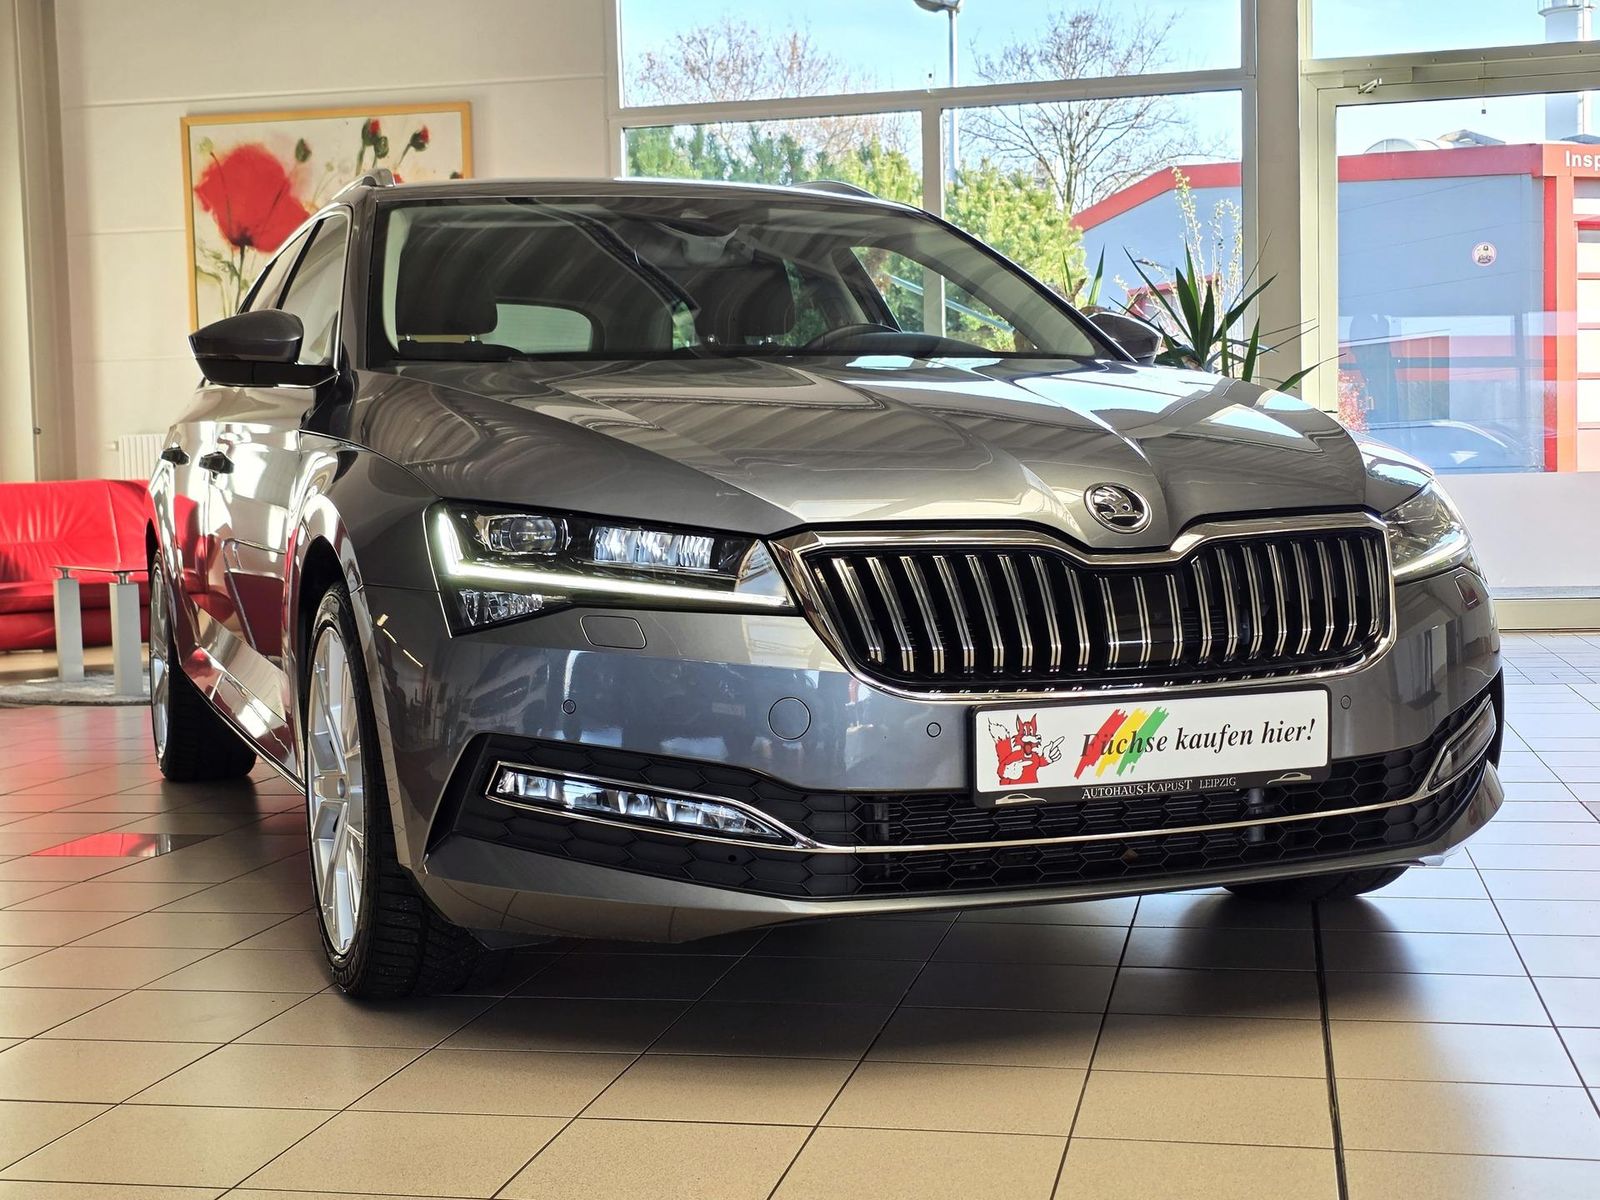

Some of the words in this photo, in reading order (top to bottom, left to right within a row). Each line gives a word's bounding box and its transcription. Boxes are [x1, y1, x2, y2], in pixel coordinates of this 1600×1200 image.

[1080, 730, 1168, 756] Füchse
[1175, 724, 1253, 753] kaufen
[1261, 718, 1315, 743] hier!
[1200, 777, 1236, 789] LEIPZIG
